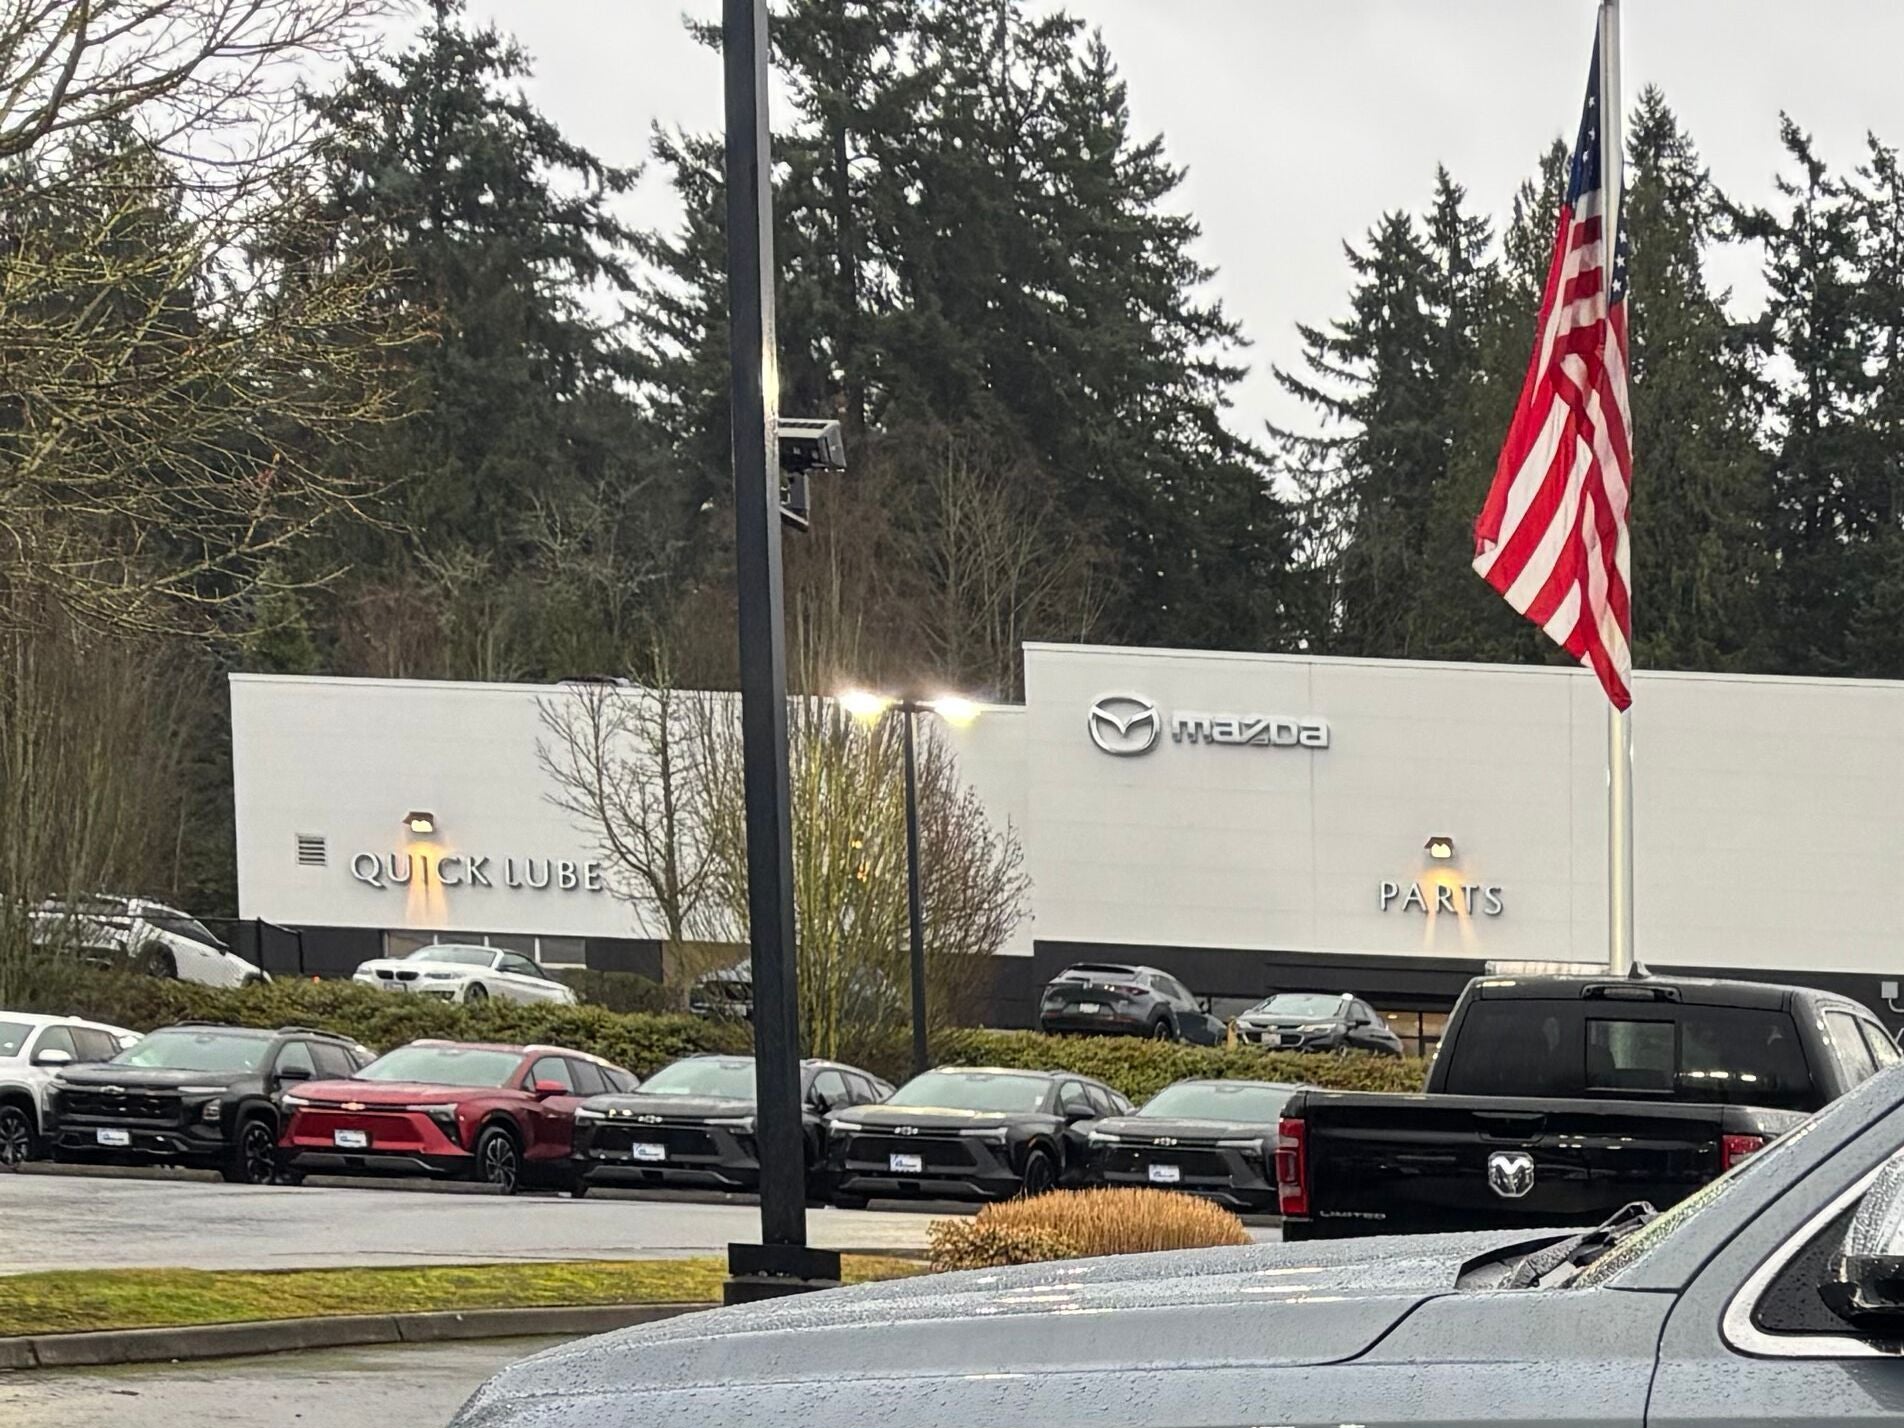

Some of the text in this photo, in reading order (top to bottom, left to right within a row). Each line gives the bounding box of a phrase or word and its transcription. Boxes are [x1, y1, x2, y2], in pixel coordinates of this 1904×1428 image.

[350, 852, 603, 891] QUICK LUBE
[1379, 880, 1504, 916] PARTS
